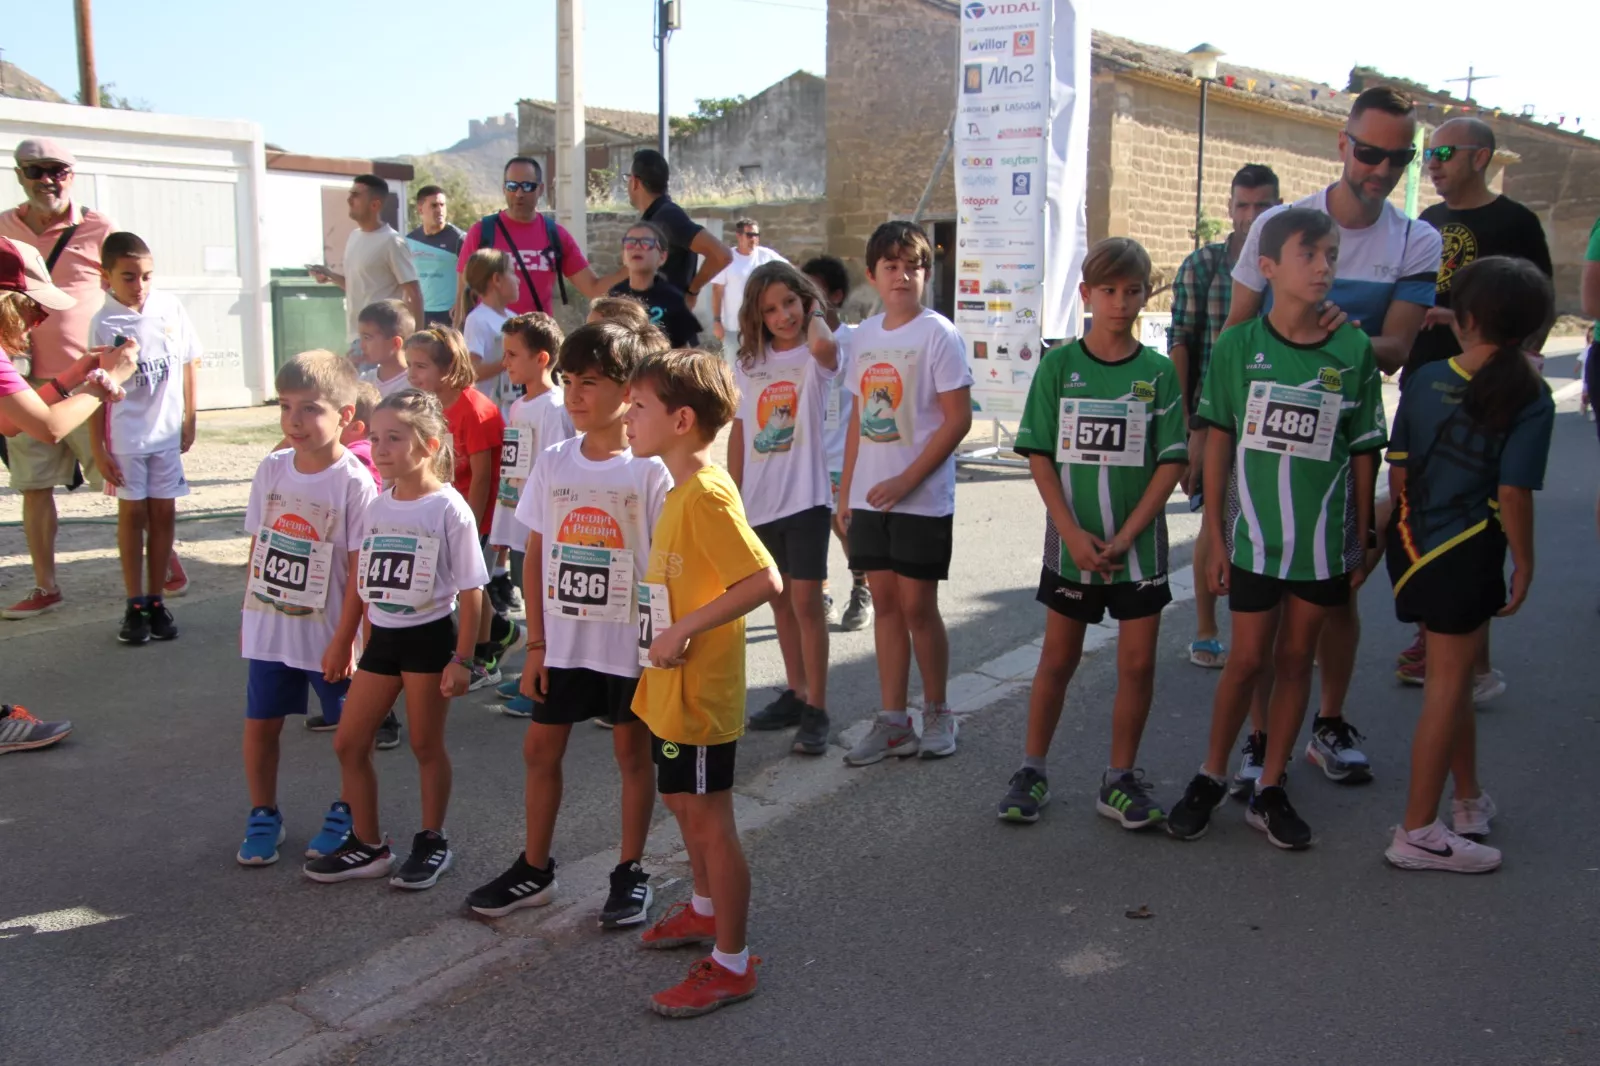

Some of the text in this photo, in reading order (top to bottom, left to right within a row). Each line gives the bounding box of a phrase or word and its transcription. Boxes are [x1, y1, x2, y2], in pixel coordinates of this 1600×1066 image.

[988, 1, 1040, 15] VIDAL
[979, 38, 1007, 50] villar
[1078, 422, 1121, 446] 571
[1266, 408, 1316, 437] 488
[265, 555, 306, 585] 420
[369, 558, 410, 584] 414
[560, 570, 606, 599] 436
